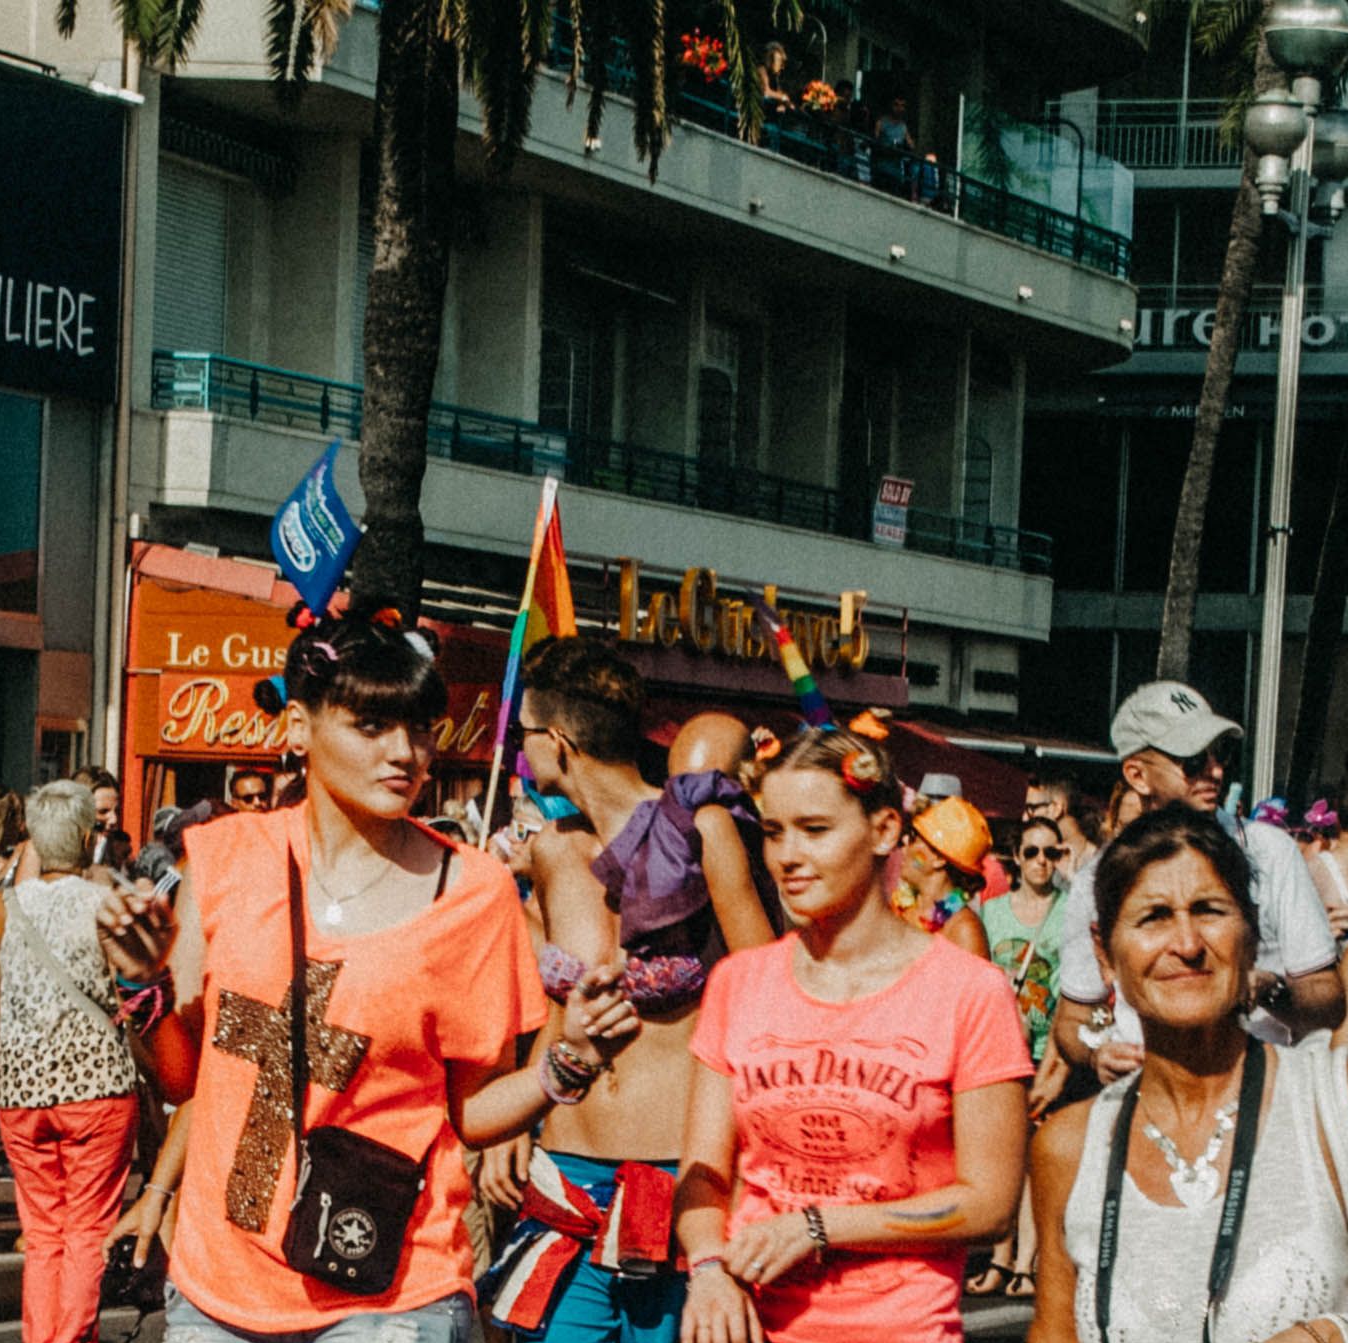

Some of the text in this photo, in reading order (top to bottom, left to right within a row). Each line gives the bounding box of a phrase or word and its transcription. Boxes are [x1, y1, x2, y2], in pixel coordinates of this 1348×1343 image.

[166, 632, 289, 668] Le Gus
[737, 1059, 805, 1103] JACK
[337, 1212, 373, 1232] CONVERSE
[346, 1246, 365, 1256] STAR
